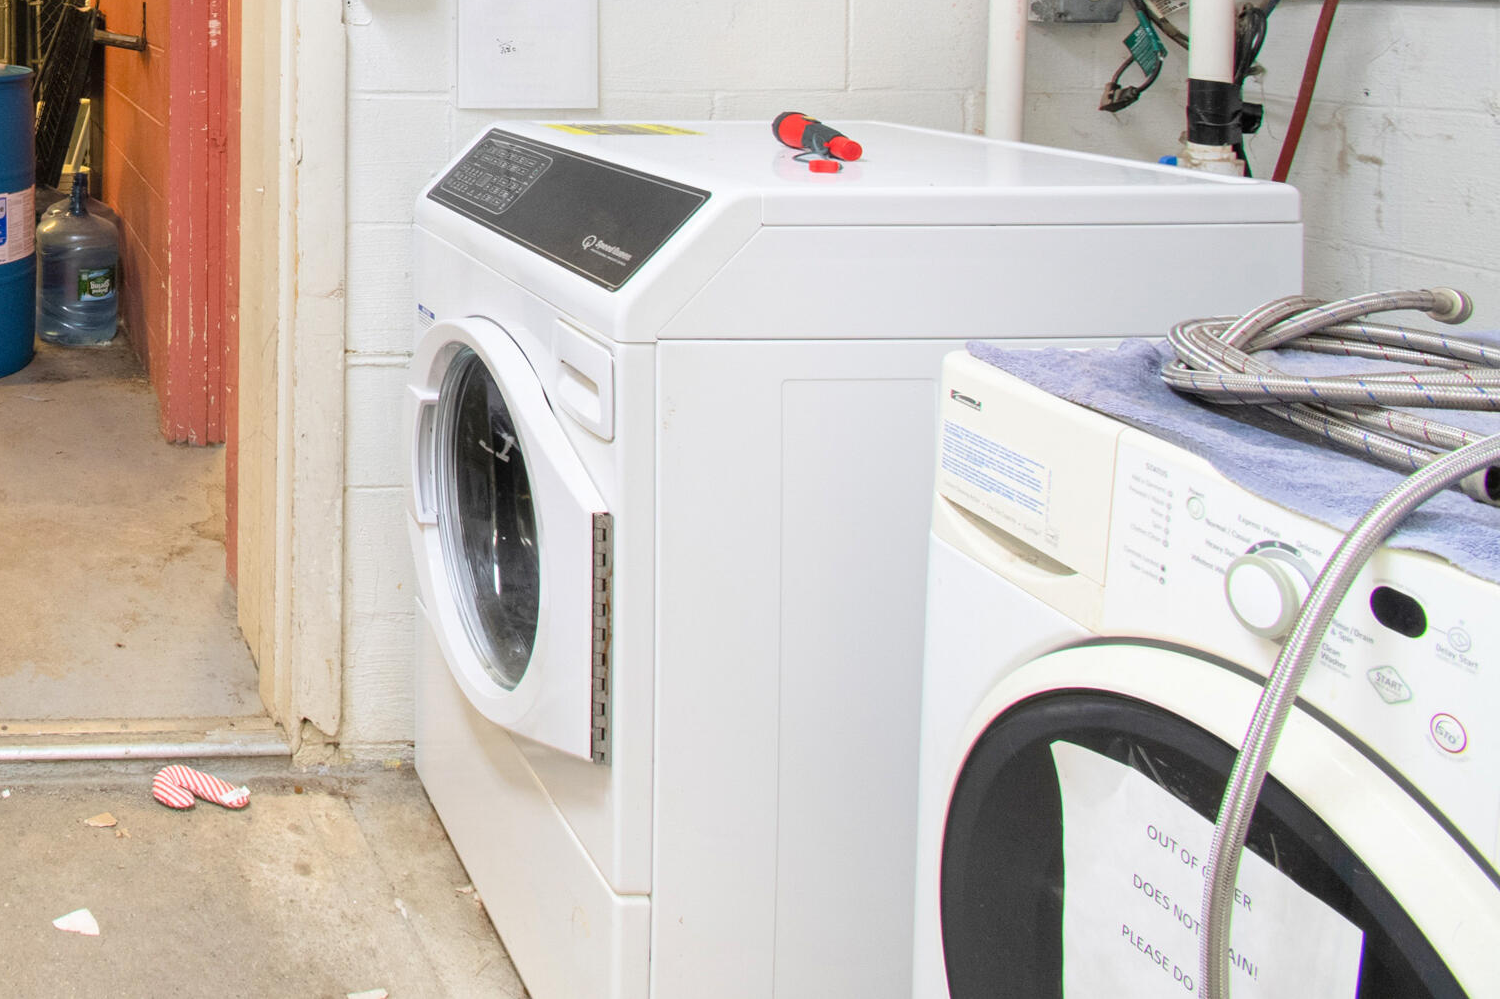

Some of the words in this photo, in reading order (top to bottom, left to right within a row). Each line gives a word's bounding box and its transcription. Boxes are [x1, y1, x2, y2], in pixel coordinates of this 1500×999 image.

[1375, 670, 1403, 691] START
[1147, 824, 1179, 854] OUT
[1180, 849, 1198, 869] OF
[1133, 873, 1170, 910] DOES
[1173, 904, 1201, 935] NOT
[1122, 924, 1169, 972] PLEASE
[1173, 965, 1194, 991] DO
